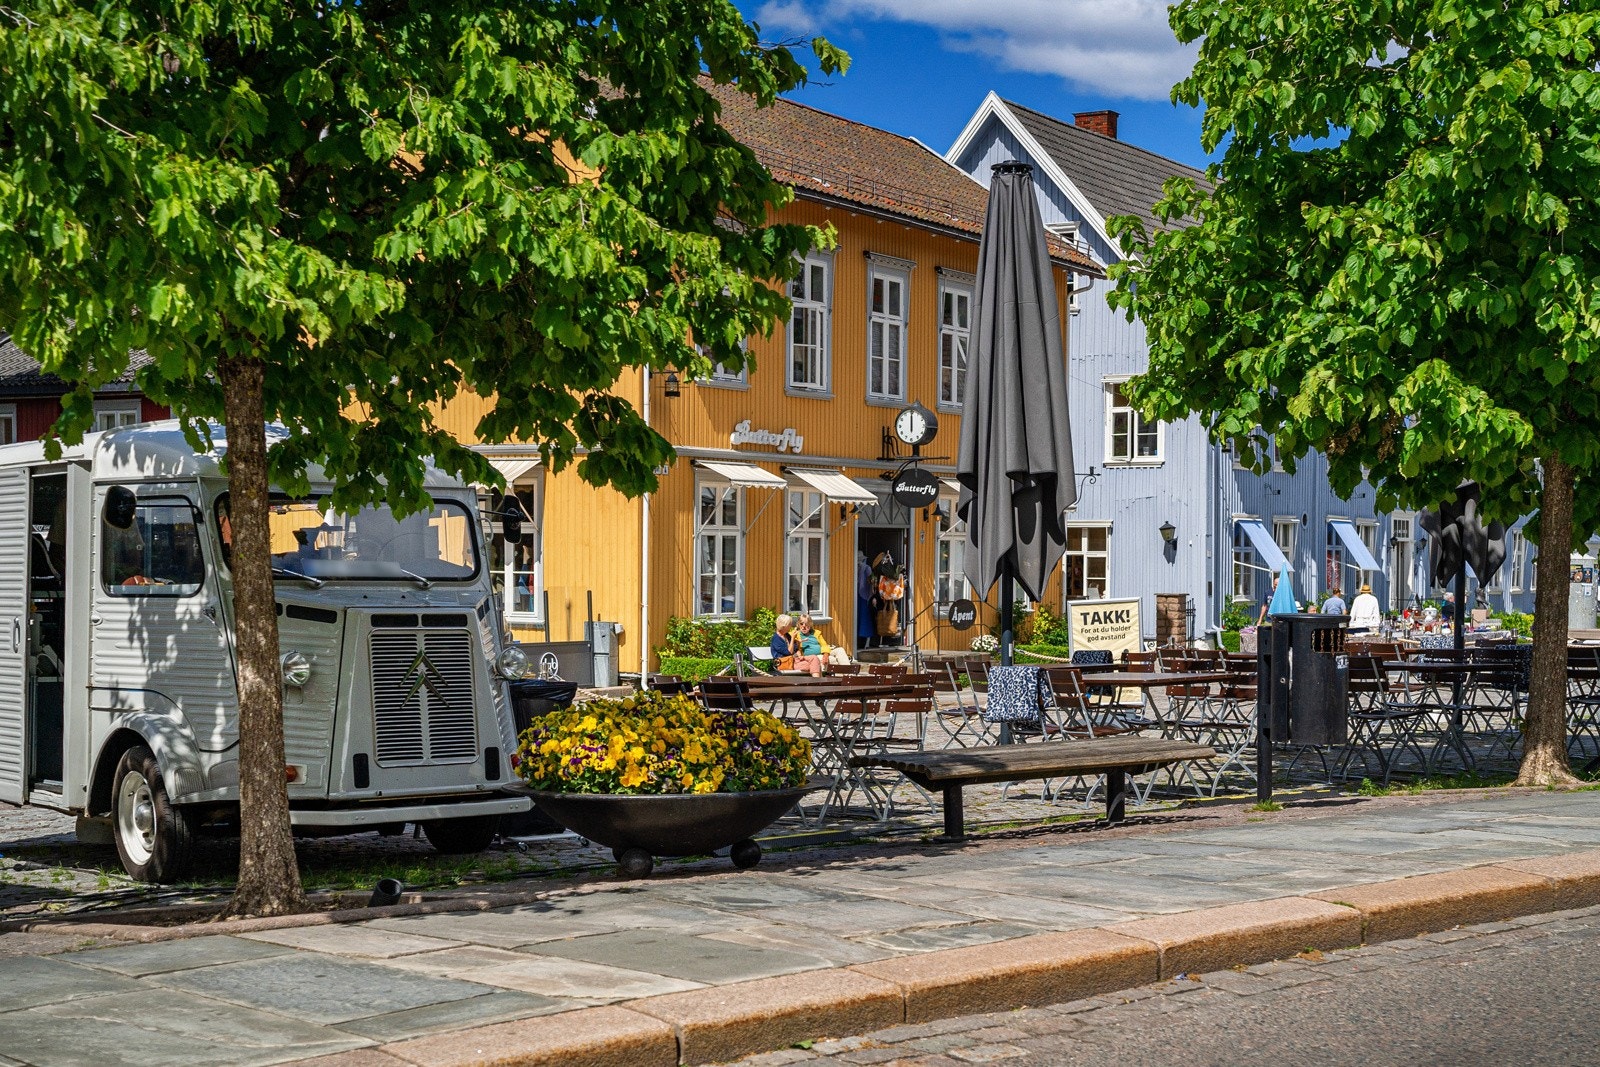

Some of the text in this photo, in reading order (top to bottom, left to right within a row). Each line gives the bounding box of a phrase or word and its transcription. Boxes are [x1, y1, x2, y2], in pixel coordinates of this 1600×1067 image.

[730, 420, 803, 453] Butterfly
[896, 482, 936, 495] Butterfly
[951, 606, 974, 623] Åpent
[1080, 609, 1131, 625] TAKK!
[1087, 633, 1126, 643] god avstand
